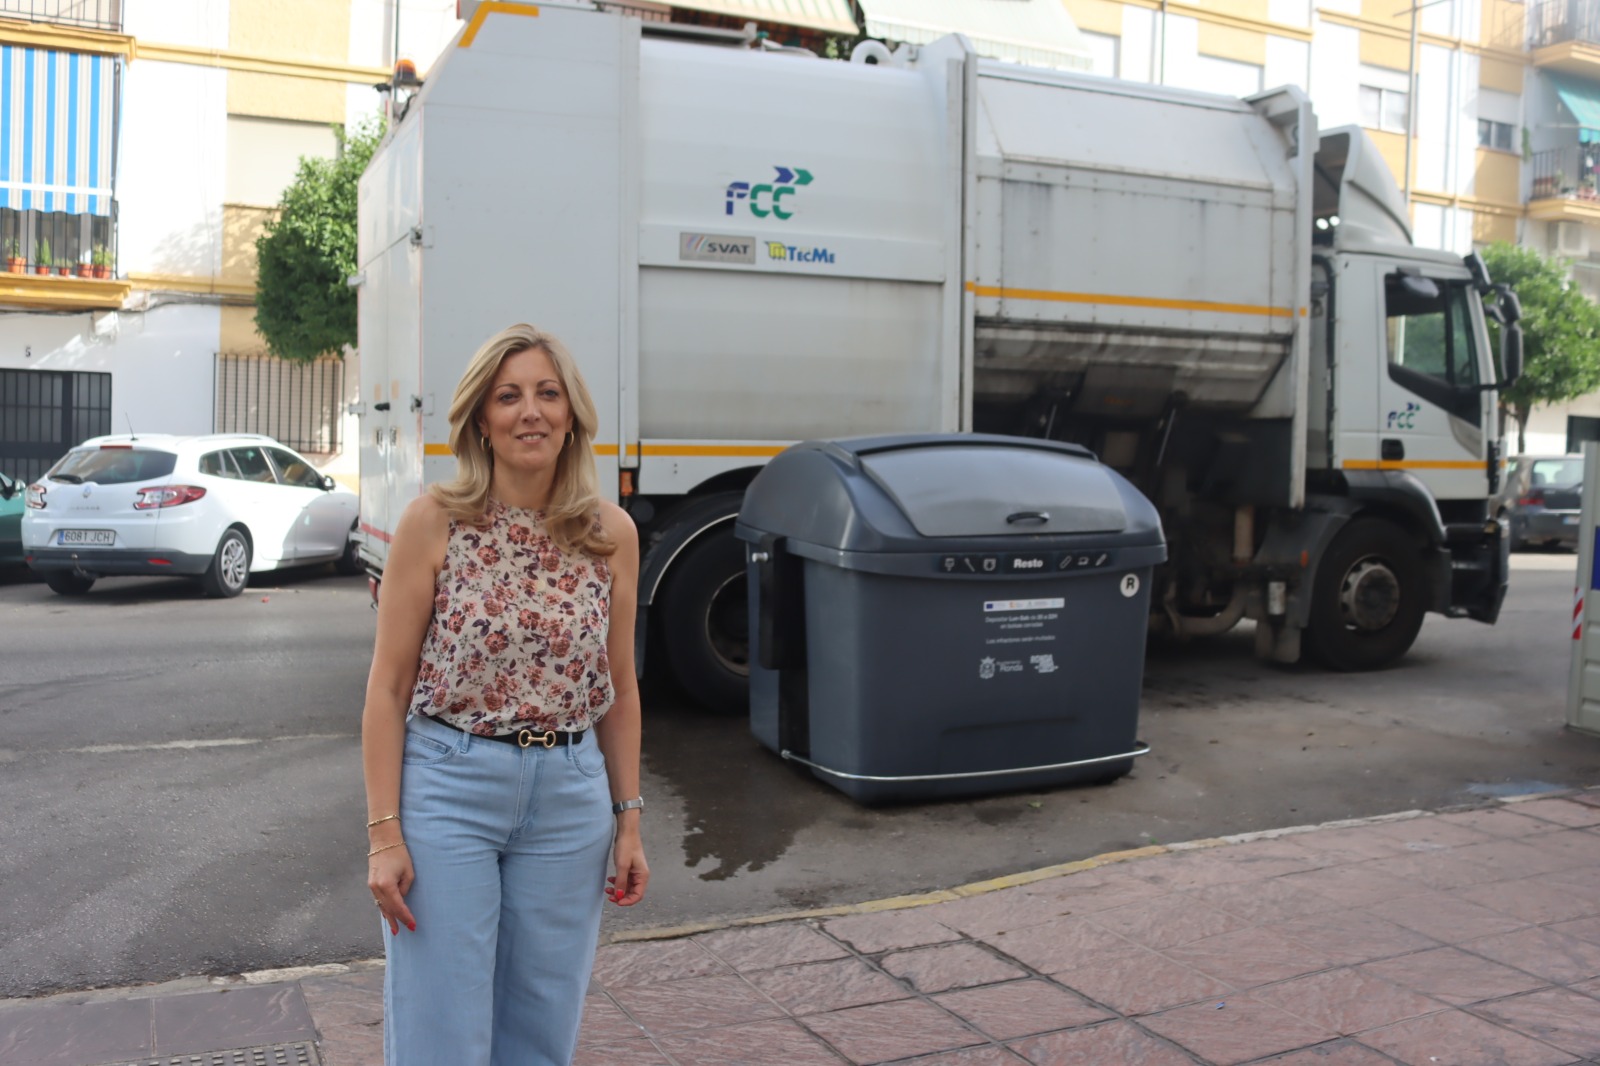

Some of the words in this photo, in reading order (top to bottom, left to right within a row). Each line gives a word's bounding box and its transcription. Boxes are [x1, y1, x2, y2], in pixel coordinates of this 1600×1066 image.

[725, 182, 796, 220] FCC
[708, 242, 750, 254] SVAT
[25, 346, 31, 358] 5
[1387, 411, 1415, 429] FCC
[65, 531, 88, 542] 6081
[91, 531, 110, 542] JCH
[1013, 558, 1043, 569] Resto
[1126, 577, 1136, 590] R
